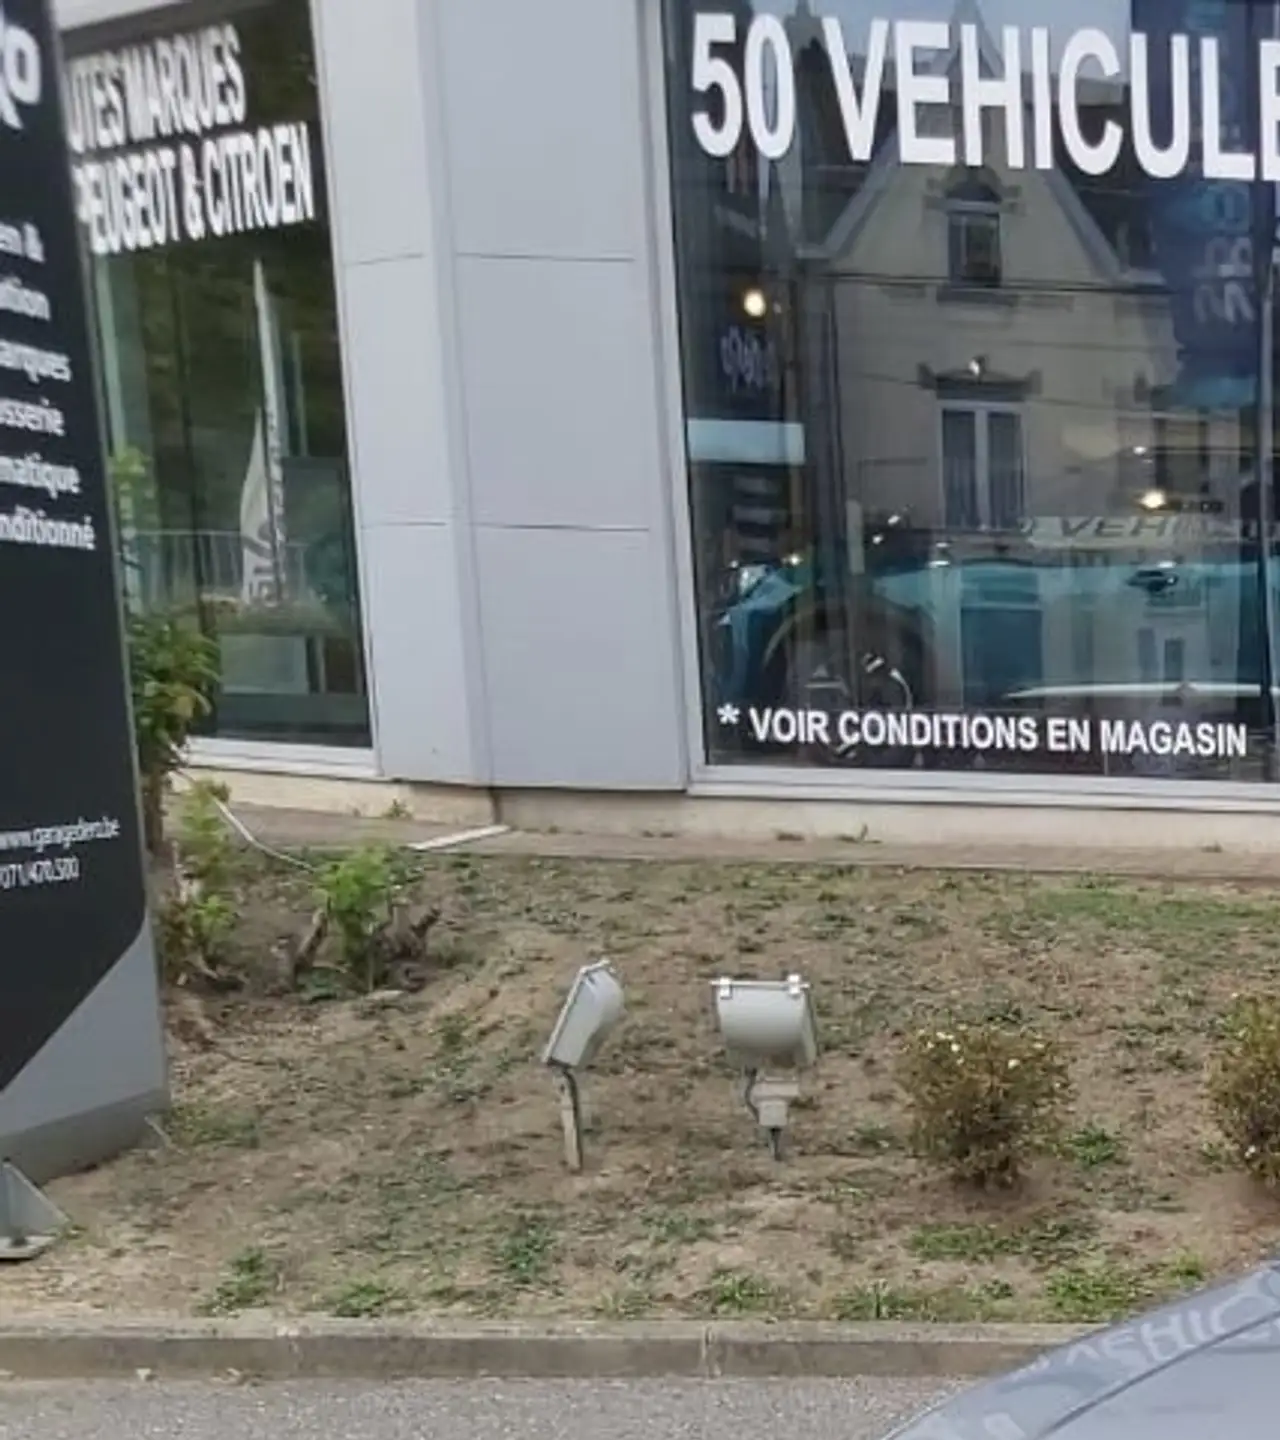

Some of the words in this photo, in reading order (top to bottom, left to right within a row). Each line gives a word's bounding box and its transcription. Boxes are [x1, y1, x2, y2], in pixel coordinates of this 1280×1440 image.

[66, 51, 126, 154] UTES
[122, 24, 246, 142] MARQUES
[689, 11, 796, 162] 50
[202, 121, 314, 238] CITROEN
[748, 707, 832, 746] VOIR
[836, 708, 1039, 752] CONDITIONS
[1046, 717, 1091, 753] EN
[1101, 719, 1247, 758] MAGASIN
